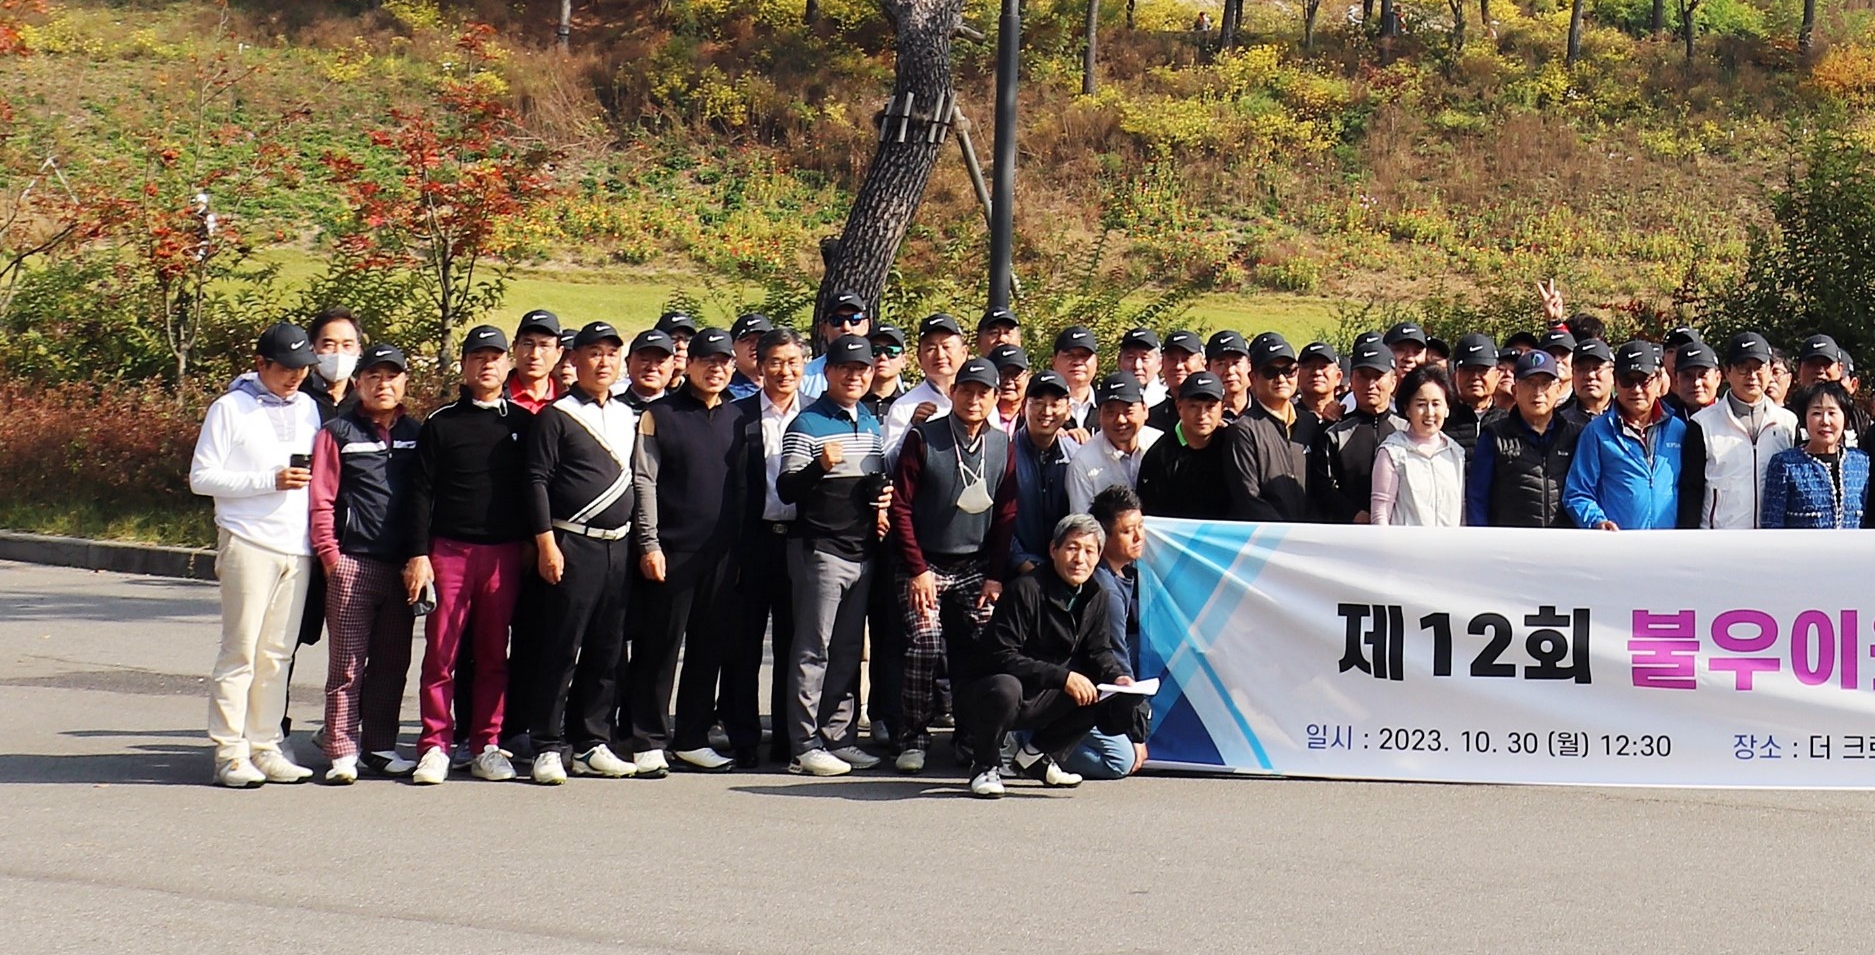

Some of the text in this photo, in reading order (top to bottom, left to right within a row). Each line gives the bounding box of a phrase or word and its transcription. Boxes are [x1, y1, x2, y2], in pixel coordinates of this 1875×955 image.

[1336, 601, 1594, 686] 제12회
[1305, 723, 1353, 751] 일시
[1379, 727, 1450, 753] 2023.
[1461, 730, 1498, 754] 10.
[1507, 731, 1539, 756] 30
[1548, 730, 1590, 759] (월)
[1600, 734, 1673, 758] 12:30
[1733, 734, 1783, 760] 장소
[1809, 734, 1832, 761] 더
